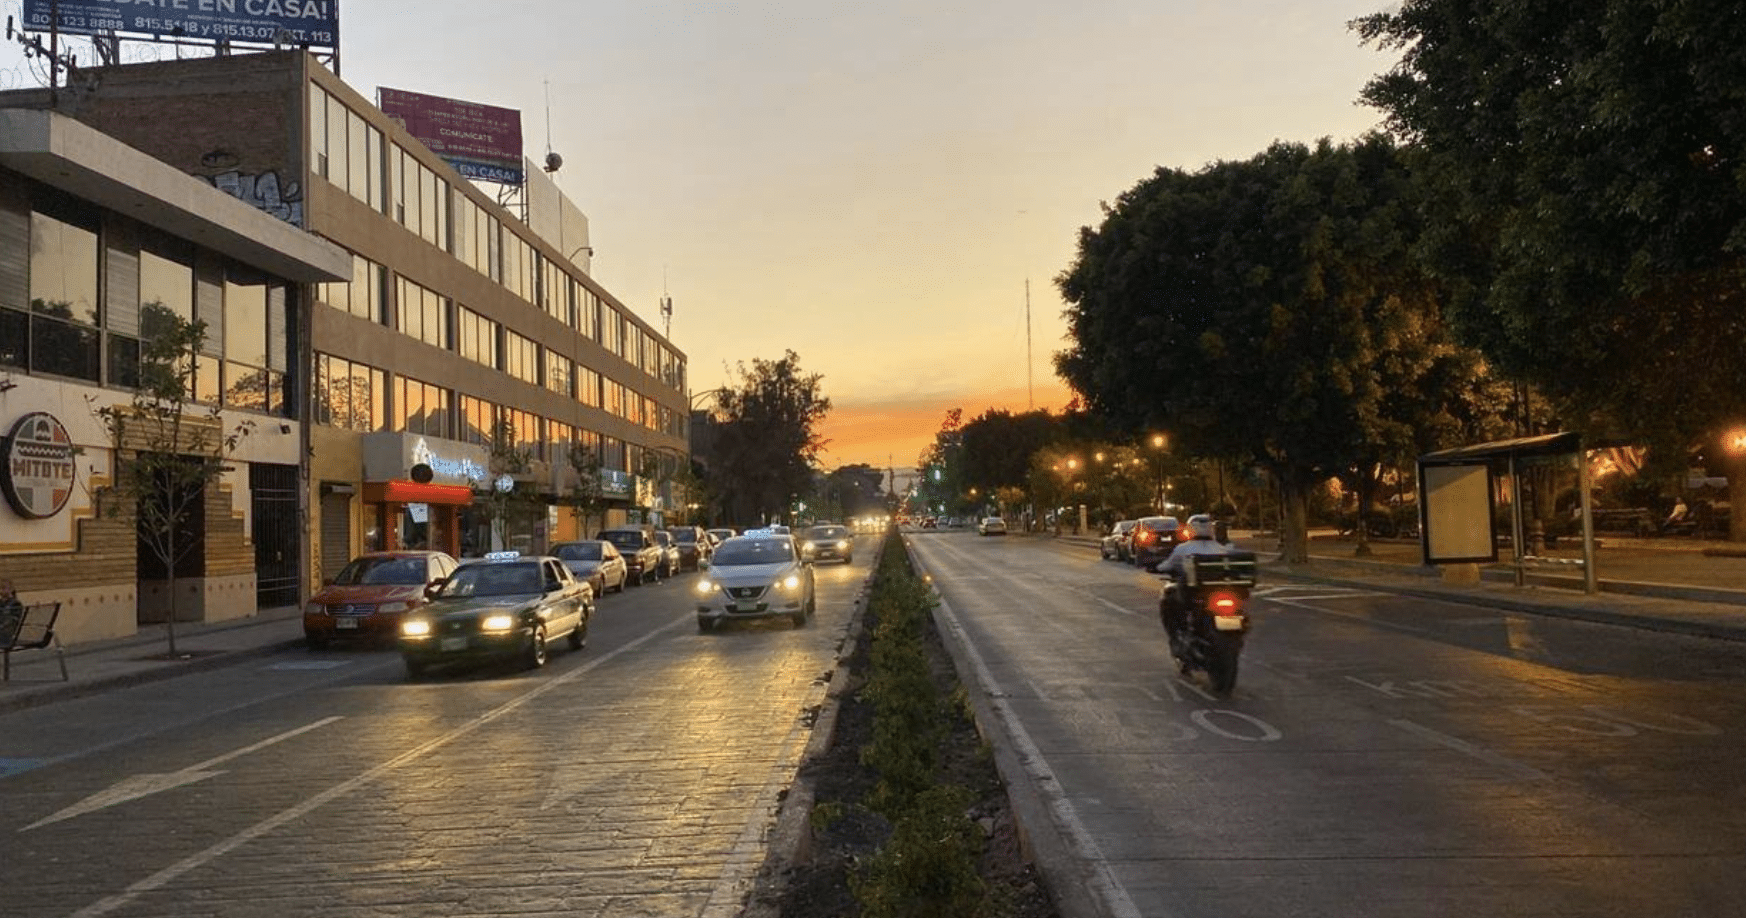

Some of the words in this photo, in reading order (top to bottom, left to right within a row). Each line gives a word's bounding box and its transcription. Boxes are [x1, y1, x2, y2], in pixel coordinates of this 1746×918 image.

[244, 0, 327, 20] CASA!
[64, 16, 86, 26] 123
[90, 18, 125, 30] 8888
[201, 24, 211, 36] y
[213, 23, 276, 39] 815.13.07
[311, 30, 332, 42] 113
[460, 165, 477, 175] EN
[480, 167, 515, 181] CASA!
[13, 458, 71, 479] MITOTE
